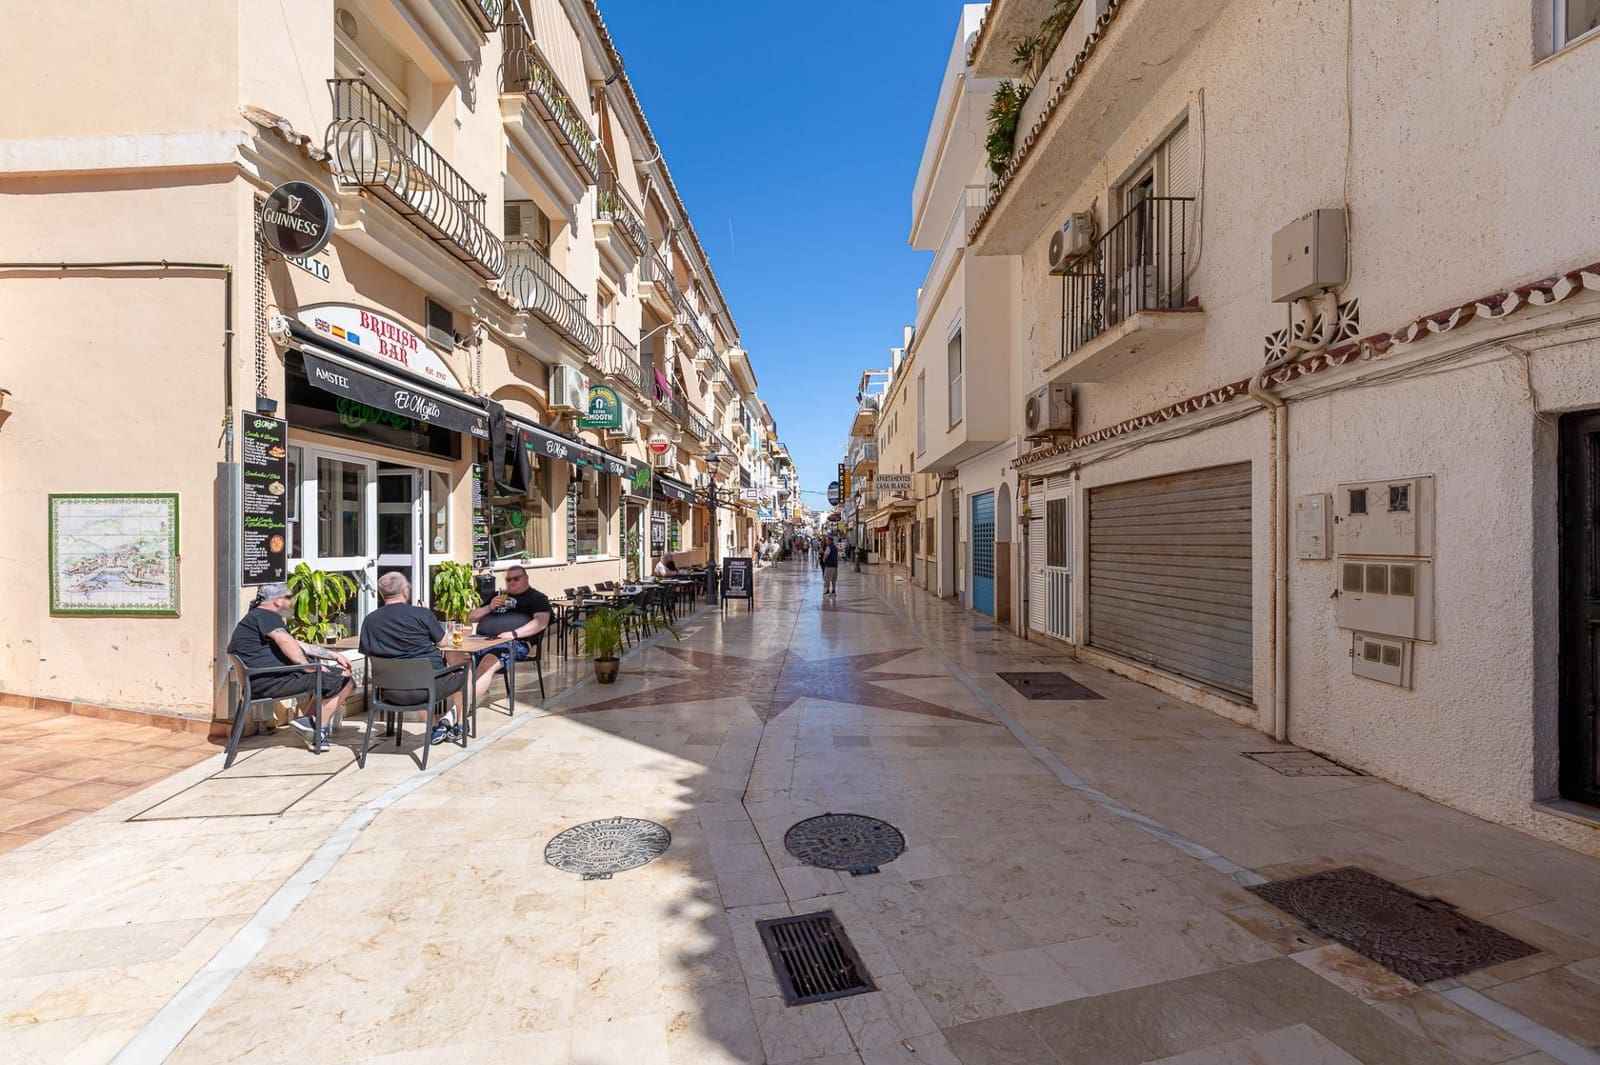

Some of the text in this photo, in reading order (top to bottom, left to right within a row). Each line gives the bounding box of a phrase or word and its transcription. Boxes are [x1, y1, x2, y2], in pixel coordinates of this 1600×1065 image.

[263, 207, 319, 236] GUINNESS
[360, 310, 418, 354] BRITISH
[378, 338, 409, 368] BAR
[315, 368, 349, 388] AMSTEL
[394, 391, 410, 410] El
[409, 396, 441, 420] Mojito
[586, 413, 613, 421] MOOTH
